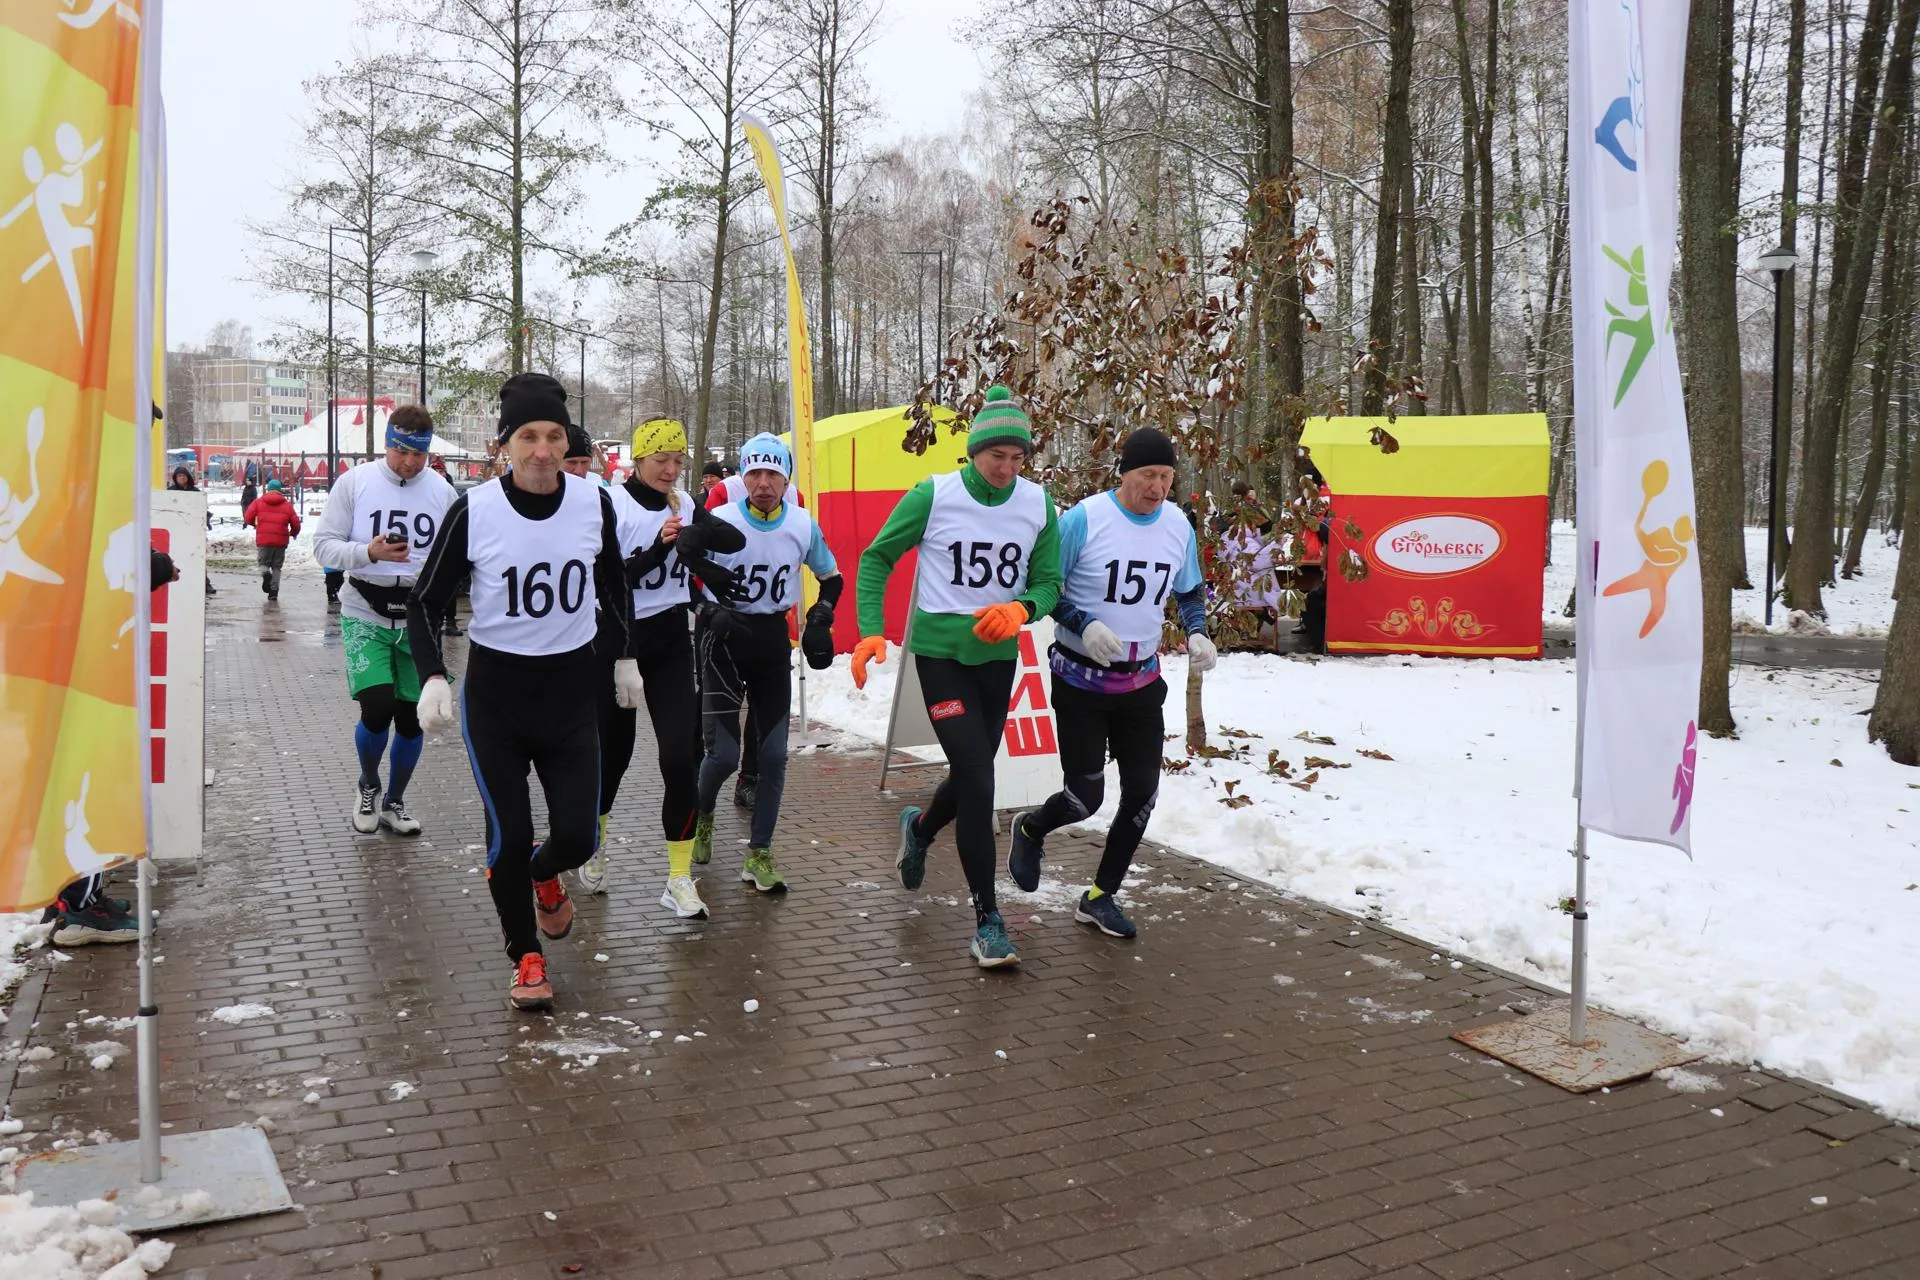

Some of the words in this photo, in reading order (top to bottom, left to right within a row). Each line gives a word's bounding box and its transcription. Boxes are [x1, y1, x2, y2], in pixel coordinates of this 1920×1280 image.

[743, 453, 782, 466] TITAN
[369, 509, 435, 549] 159
[1391, 536, 1484, 558] Егорьевск
[947, 541, 1023, 589] 158
[1103, 559, 1172, 606] 157
[501, 558, 587, 619] 160
